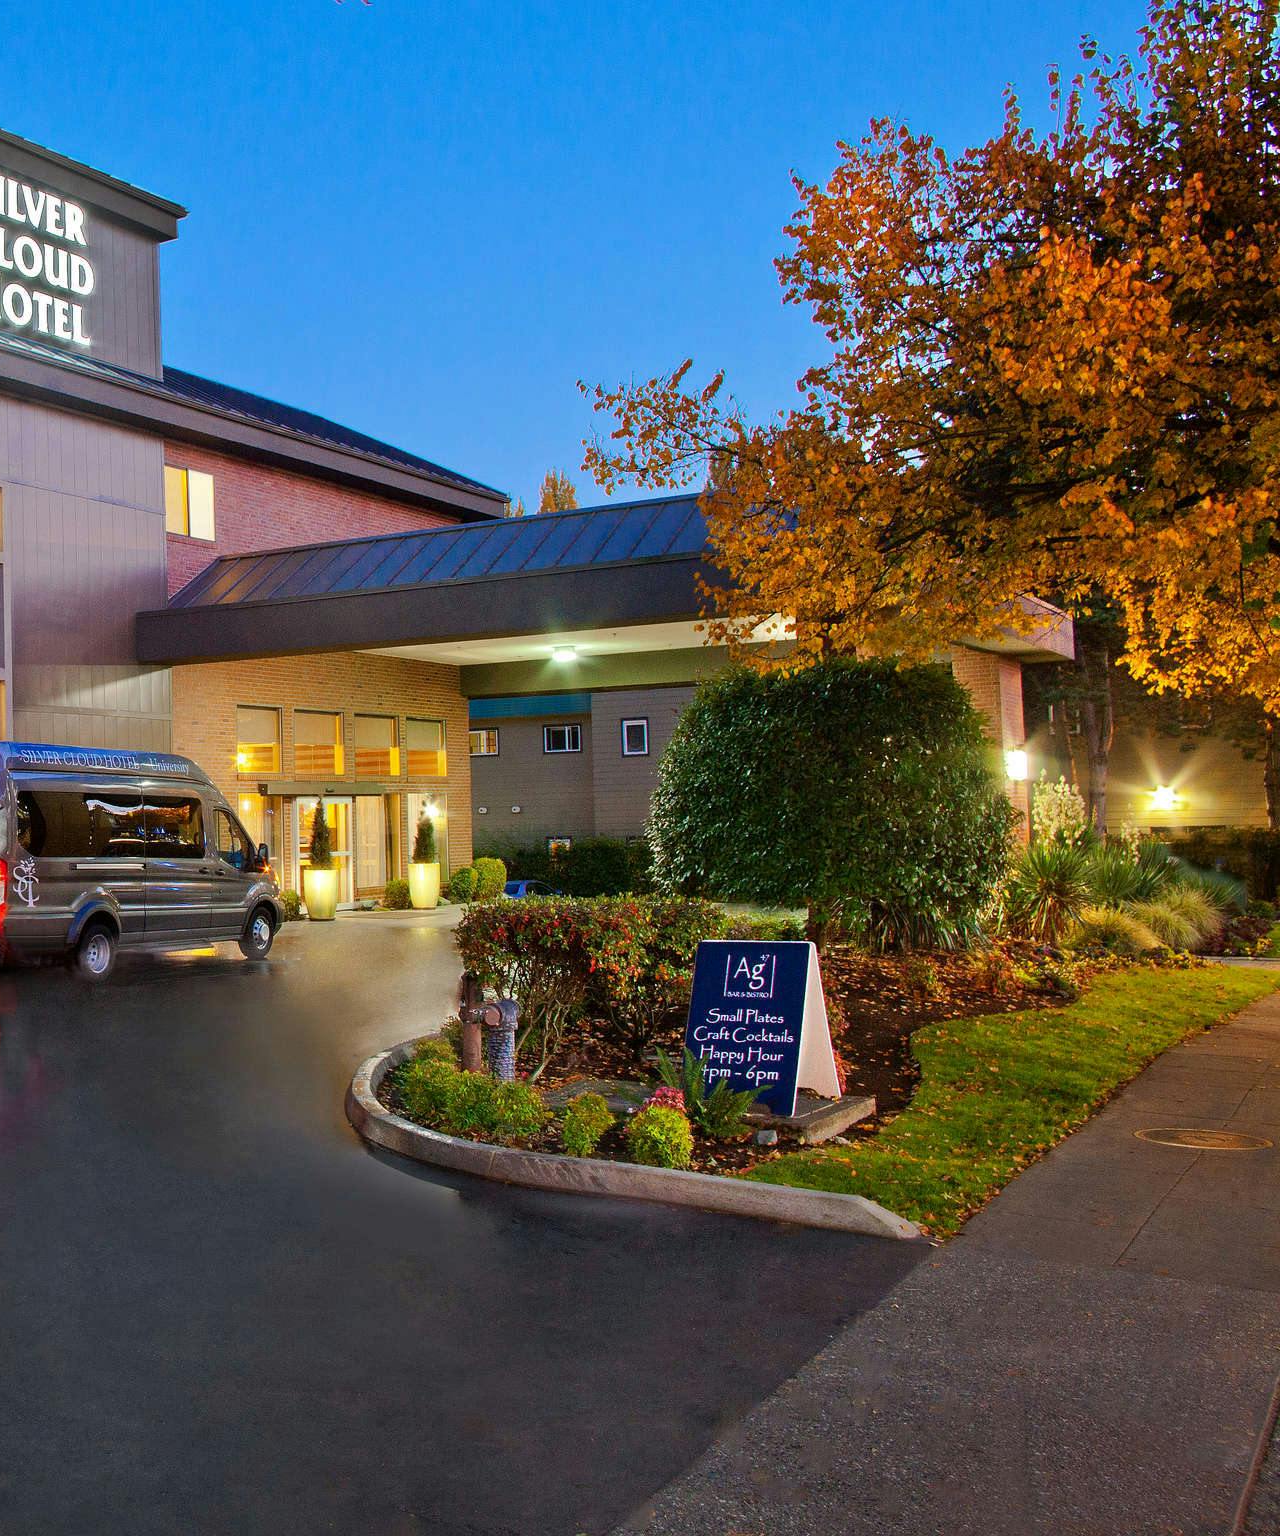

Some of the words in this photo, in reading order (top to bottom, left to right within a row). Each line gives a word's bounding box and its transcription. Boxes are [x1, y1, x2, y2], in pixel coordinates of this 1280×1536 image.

[20, 749, 62, 765] SILVER
[63, 752, 102, 767] CLOUD
[104, 755, 141, 770] HOTEL
[150, 757, 189, 775] University
[746, 991, 770, 999] BISTRO
[706, 1008, 743, 1024] Small
[745, 1008, 785, 1025] Plates
[693, 1025, 730, 1042] Craft
[732, 1027, 794, 1043] Cocktails
[699, 1044, 745, 1065] Happy
[747, 1046, 784, 1063] Hour
[745, 1064, 780, 1087] 6pm
